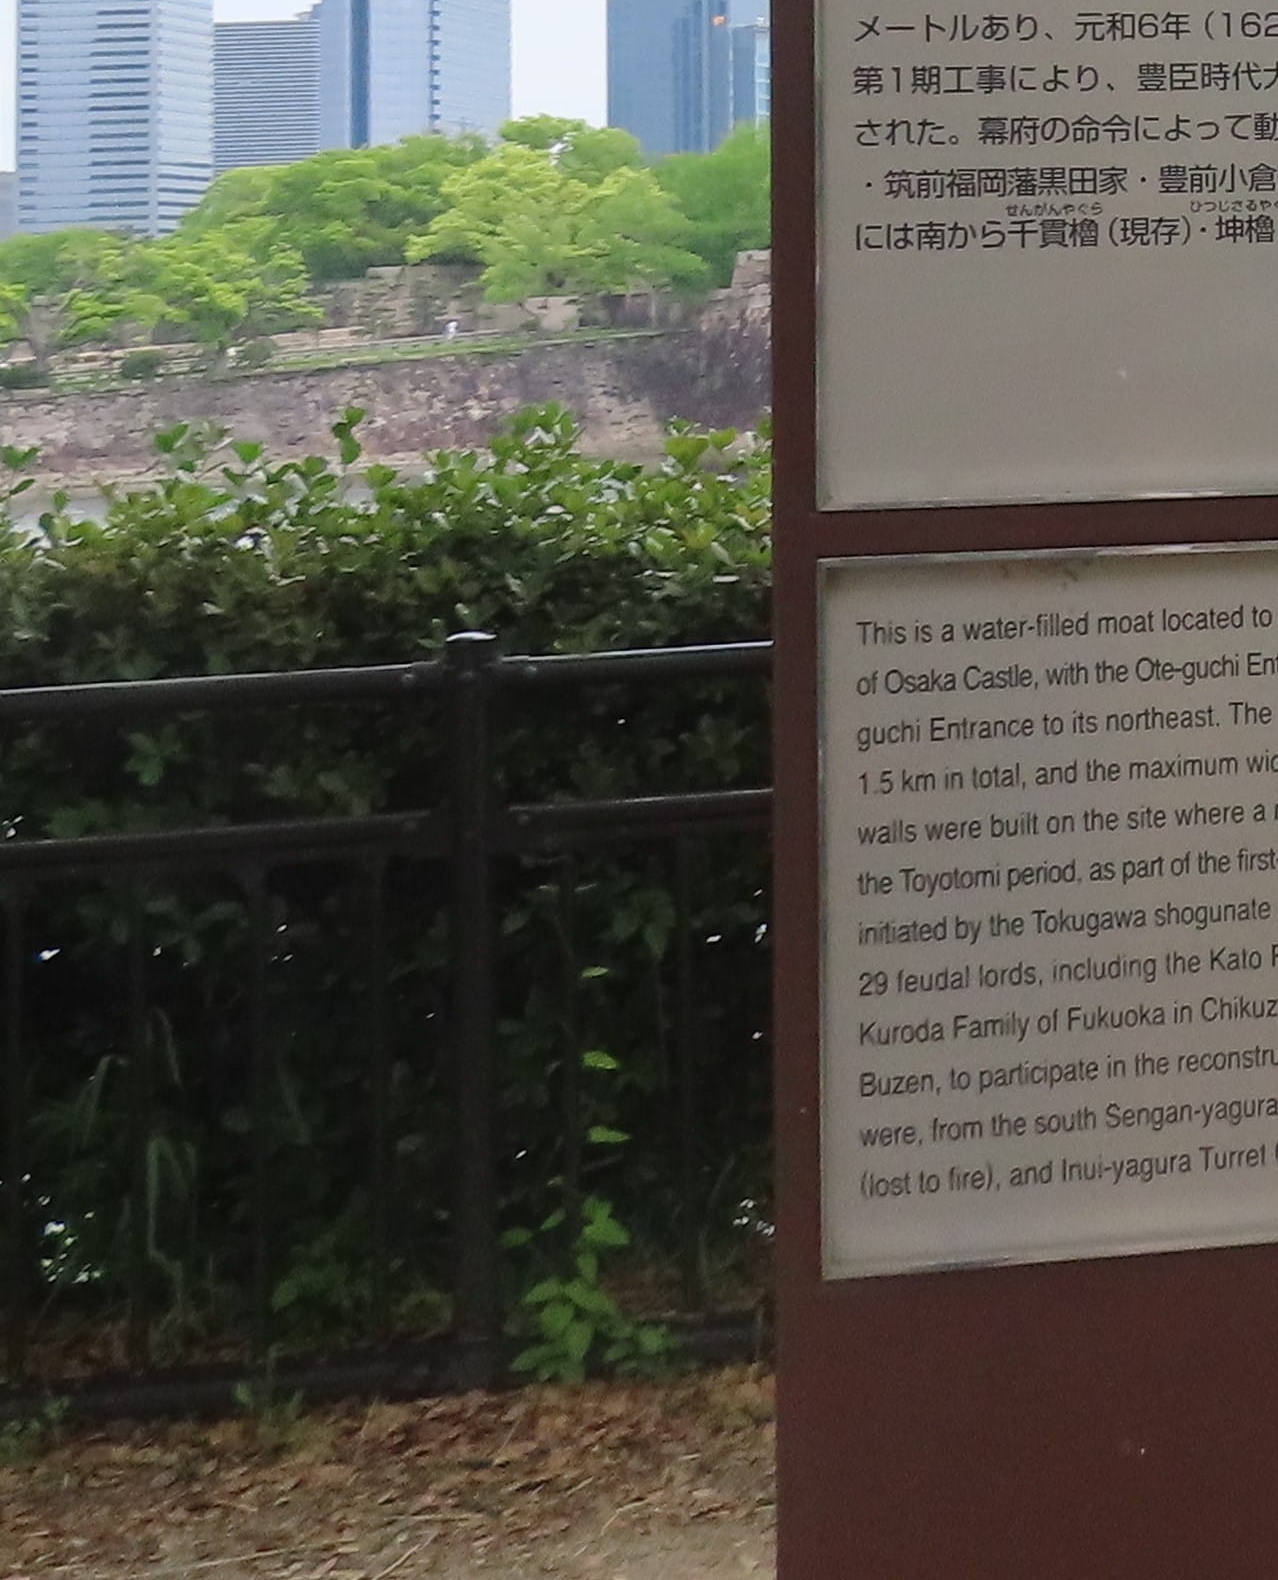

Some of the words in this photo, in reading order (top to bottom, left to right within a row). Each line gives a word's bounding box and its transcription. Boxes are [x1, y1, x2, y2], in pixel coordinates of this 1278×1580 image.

[855, 620, 907, 647] This
[914, 624, 933, 644] is
[940, 623, 955, 643] a
[962, 611, 1090, 642] water-filled
[1097, 610, 1155, 636] moat
[1161, 603, 1244, 632] located
[884, 667, 957, 695] Osaka
[962, 663, 1039, 691] Castle,
[1044, 661, 1089, 687] with
[1094, 659, 1129, 685] the
[1134, 652, 1240, 686] Ote-guchi
[856, 718, 921, 753] guchi
[929, 716, 1035, 742] Entrance
[1072, 709, 1099, 735] its
[1105, 704, 1221, 733] northeast.
[1227, 701, 1273, 726] The
[901, 768, 936, 793] km
[971, 761, 1027, 791] total,
[1034, 758, 1078, 786] and
[1085, 758, 1122, 783] the
[1128, 753, 1239, 781] maximum
[857, 819, 918, 845] walls
[924, 819, 982, 842] were
[989, 811, 1040, 838] built
[1045, 814, 1075, 835] on
[1082, 807, 1120, 833] the
[1126, 804, 1167, 830] site
[1173, 801, 1245, 827] where
[1252, 803, 1267, 823] a
[856, 871, 894, 896] the
[898, 862, 1001, 899] Toyotomi
[1089, 861, 1117, 882] as
[1122, 855, 1166, 886] part
[1196, 849, 1232, 875] the
[954, 915, 982, 946] by
[988, 912, 1025, 938] the
[1030, 907, 1148, 938] Tokugawa
[1153, 897, 1272, 931] shogunate
[858, 970, 889, 997] 29
[895, 964, 970, 994] feudal
[978, 960, 1043, 989] lords,
[1052, 954, 1157, 984] including
[1165, 950, 1201, 976] the
[1209, 946, 1263, 972] Kato
[859, 1017, 946, 1047] Kuroda
[952, 1011, 1031, 1043] Family
[1067, 1003, 1166, 1032] Fukuoka
[858, 1071, 942, 1098] Buzen,
[978, 1059, 1099, 1095] participate
[1134, 1051, 1170, 1078] the
[859, 1125, 924, 1148] were,
[931, 1117, 984, 1142] from
[990, 1112, 1027, 1138] the
[1034, 1106, 1097, 1135] south
[1105, 1097, 1278, 1132] Sengan-yagura
[918, 1170, 941, 1195] to
[1009, 1159, 1053, 1188] and
[1061, 1153, 1193, 1186] Inui-yagura
[1198, 1143, 1266, 1173] Turret
